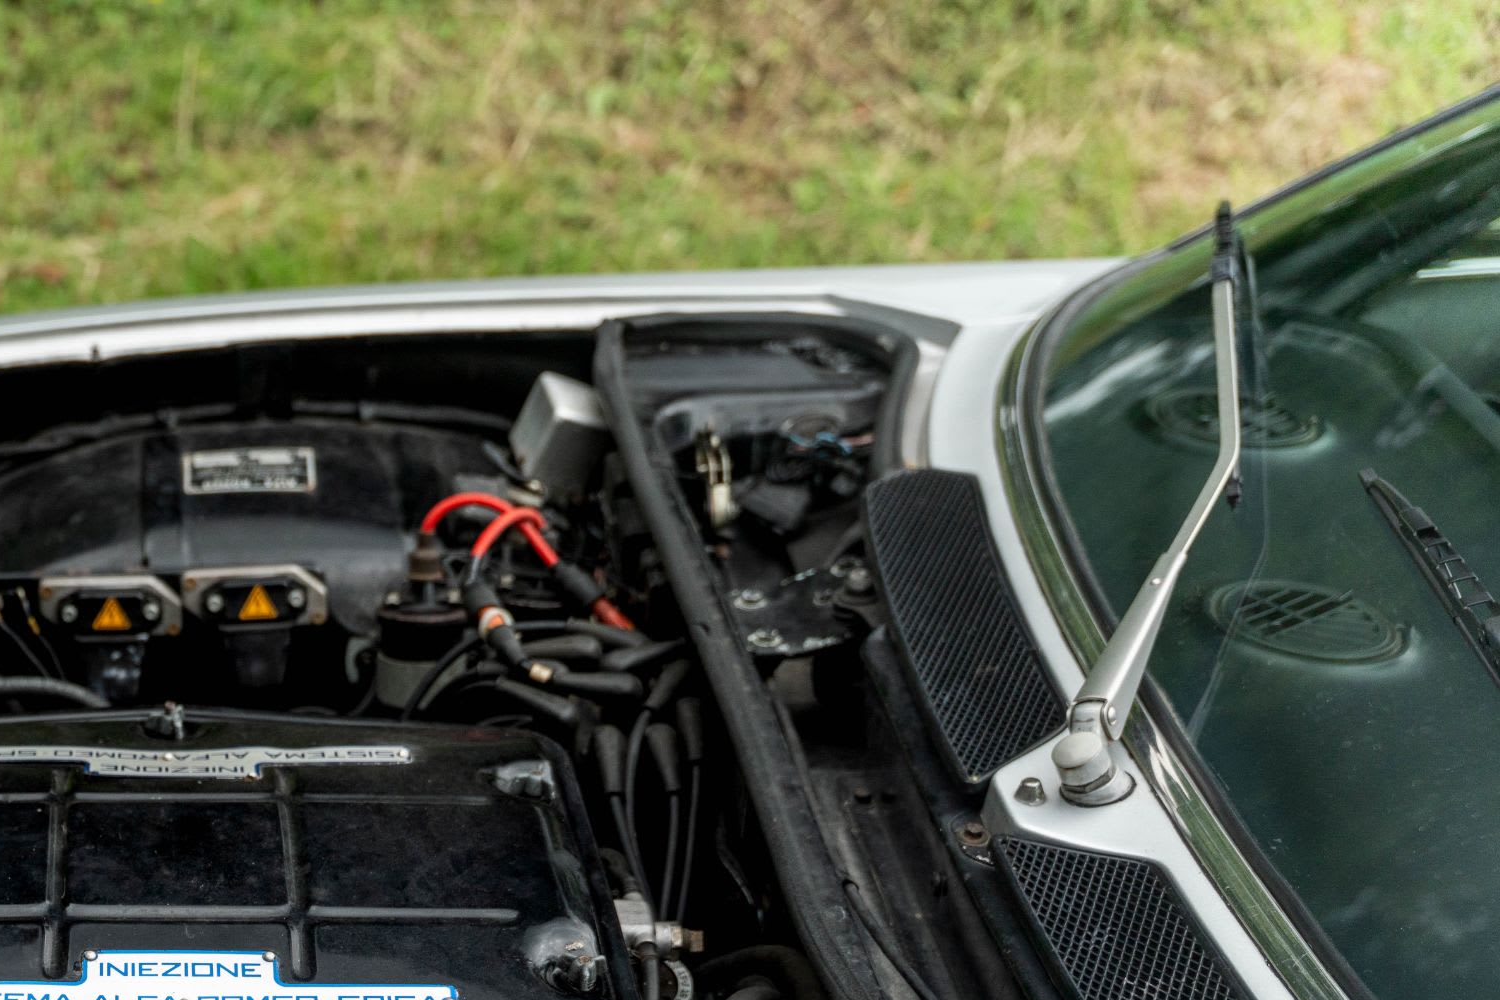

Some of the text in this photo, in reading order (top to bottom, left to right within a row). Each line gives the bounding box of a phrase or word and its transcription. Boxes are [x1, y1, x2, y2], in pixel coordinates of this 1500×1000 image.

[53, 750, 159, 761] ROMEO
[173, 752, 249, 761] ALFA
[264, 751, 395, 759] SISTEMA
[102, 763, 245, 774] INIEZIONE
[99, 962, 262, 978] INIEZIONE
